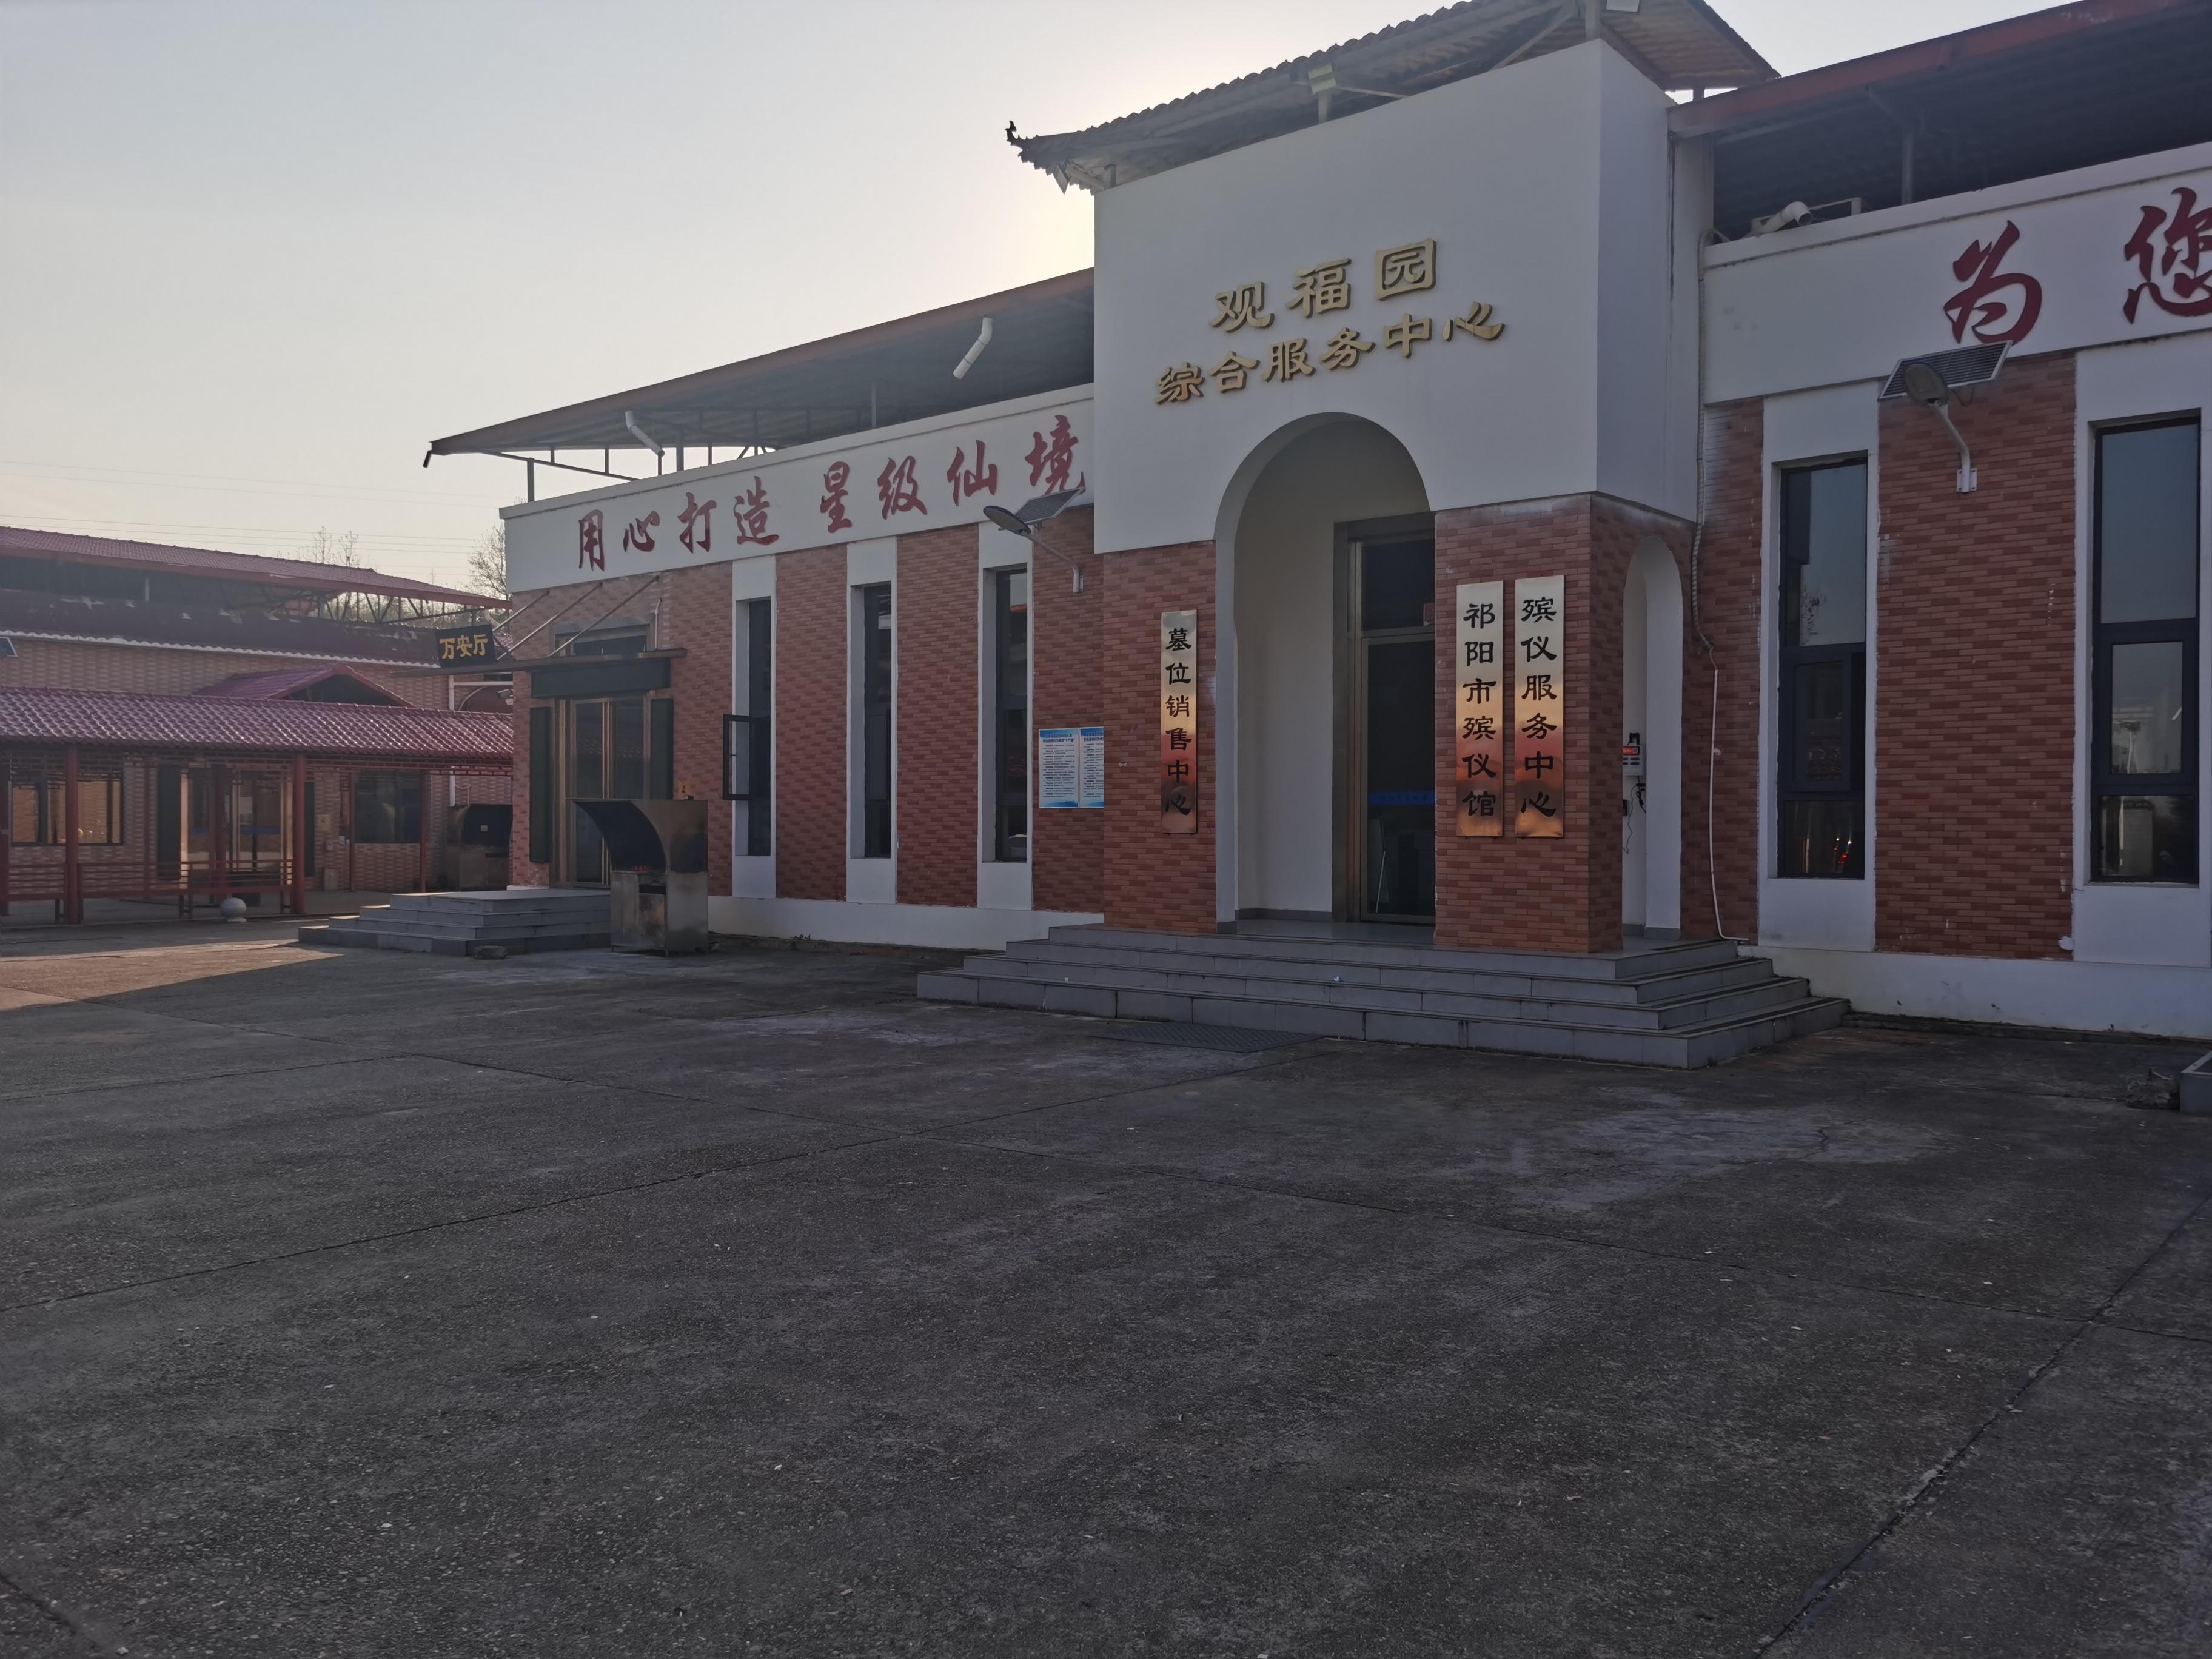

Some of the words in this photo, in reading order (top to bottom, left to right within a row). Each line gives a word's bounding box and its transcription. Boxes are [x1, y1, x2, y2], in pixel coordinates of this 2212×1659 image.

[1154, 301, 1506, 405] 综合服务中心
[1210, 238, 1437, 333] 观福园
[439, 634, 489, 660] 万安厅
[1462, 603, 1497, 817] 祁阳市殡仪馆
[1521, 597, 1558, 818] 殡仪服务中心
[1165, 628, 1192, 816] 墓位销售中心
